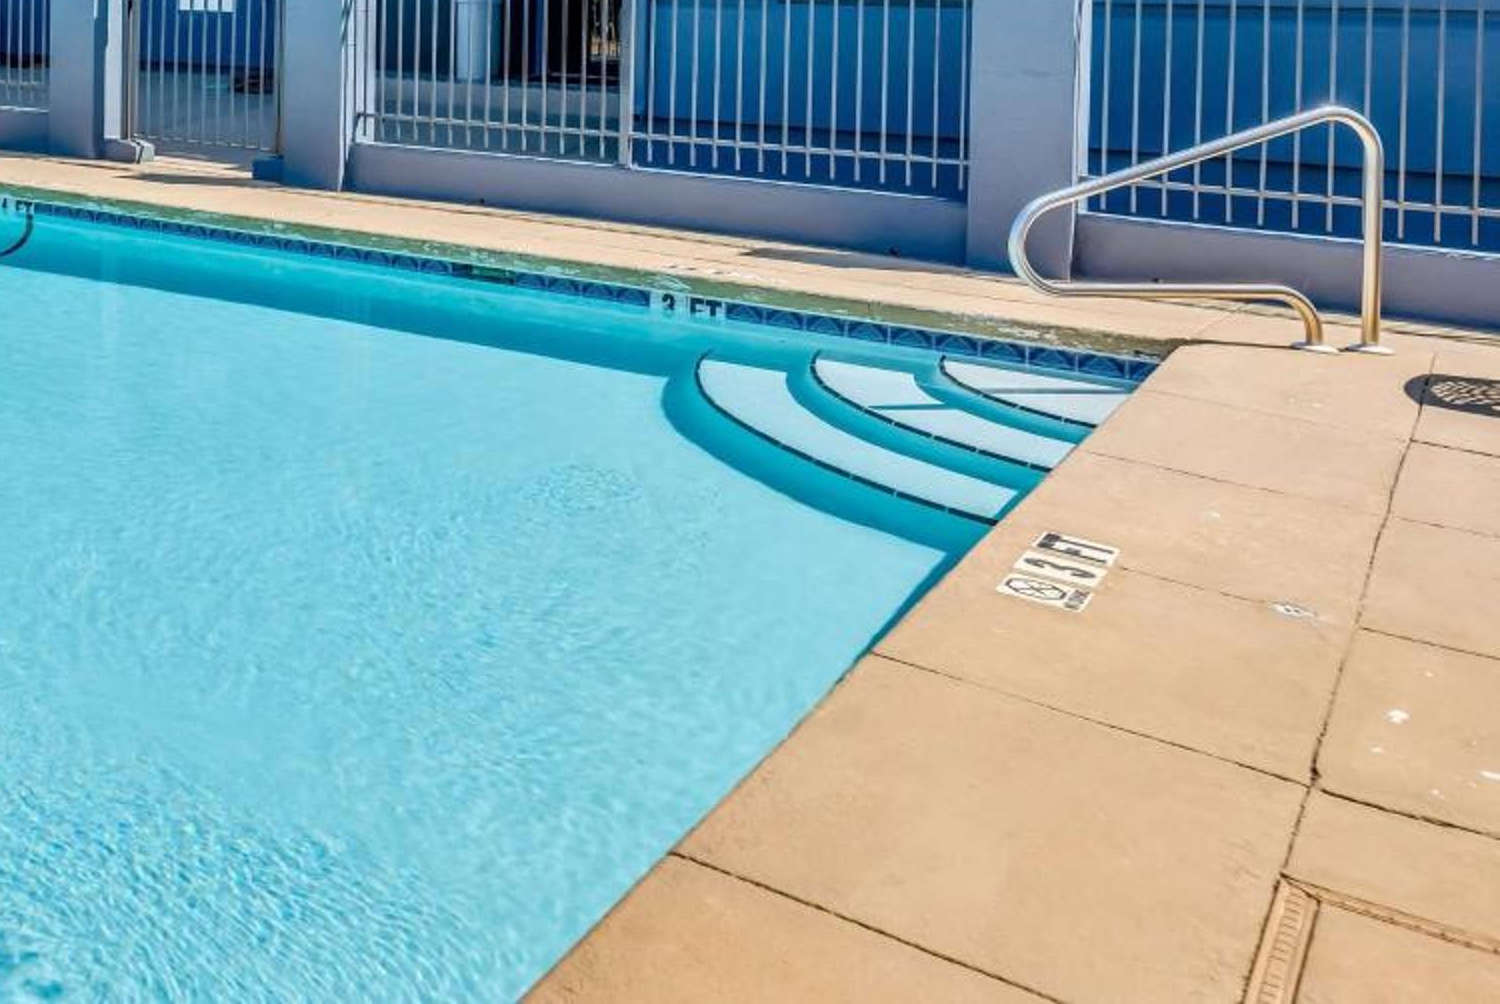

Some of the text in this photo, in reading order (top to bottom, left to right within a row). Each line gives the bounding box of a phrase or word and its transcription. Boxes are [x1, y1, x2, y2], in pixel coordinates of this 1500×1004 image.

[690, 297, 723, 317] FT
[1023, 533, 1115, 579] 3 FT
